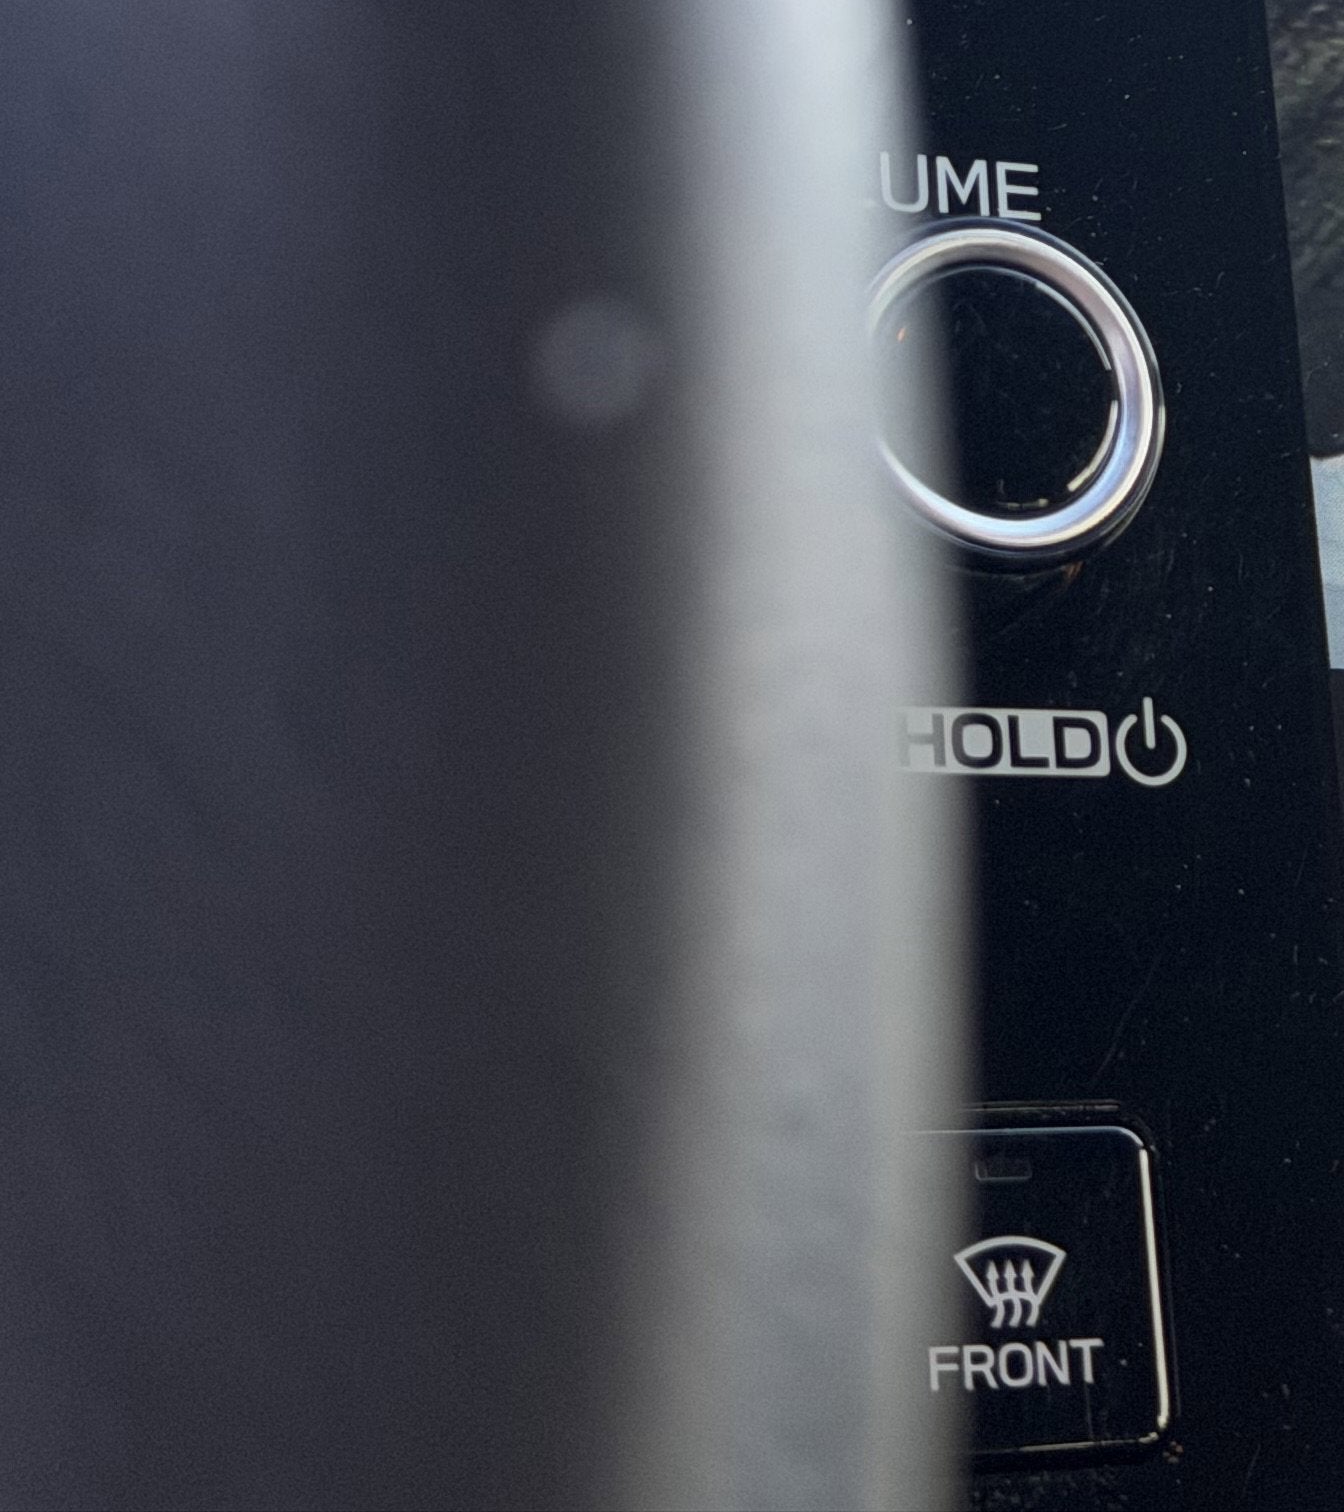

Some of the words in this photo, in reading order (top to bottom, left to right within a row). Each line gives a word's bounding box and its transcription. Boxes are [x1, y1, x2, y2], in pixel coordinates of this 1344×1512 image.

[879, 151, 1042, 221] UME
[901, 712, 1102, 770] HOLD
[928, 1337, 1104, 1392] FRONT
